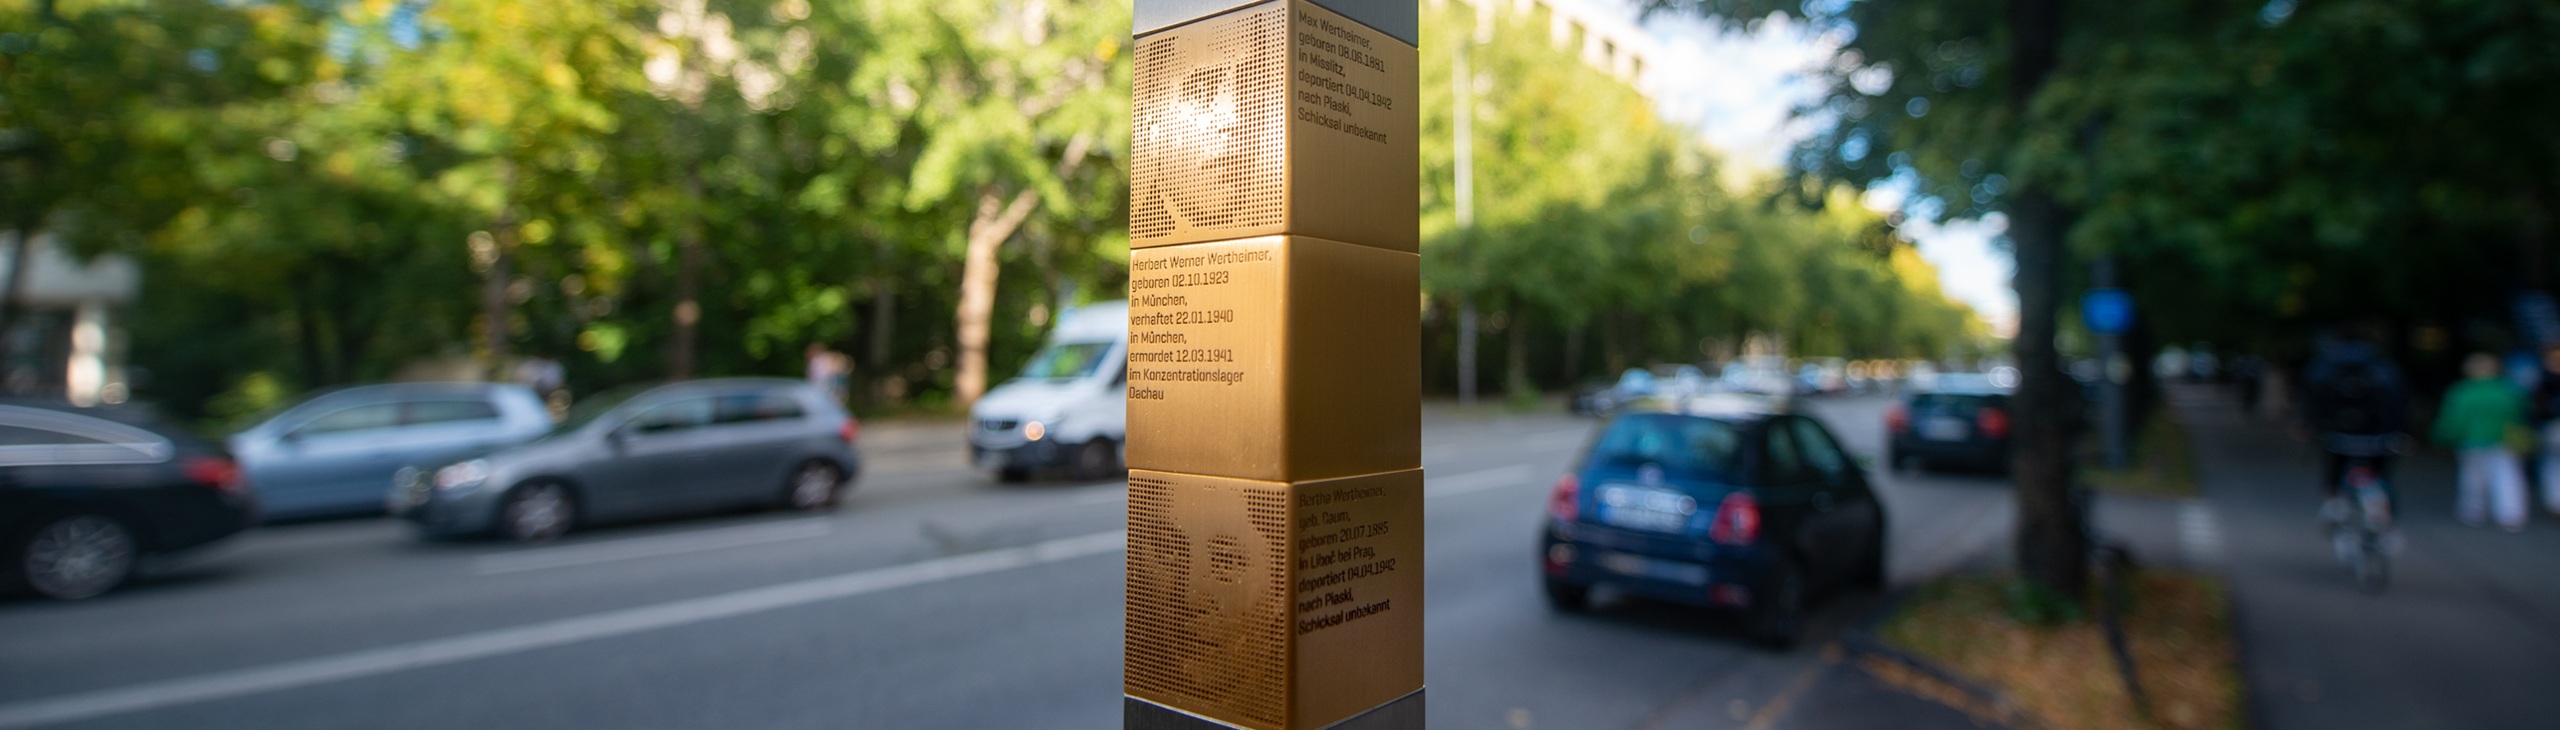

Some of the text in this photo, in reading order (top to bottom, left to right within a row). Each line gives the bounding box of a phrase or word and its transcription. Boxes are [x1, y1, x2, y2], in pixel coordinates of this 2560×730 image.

[1299, 10, 1372, 51] Max Wertheimer,
[1298, 48, 1346, 78] in Misslitz,
[1299, 32, 1385, 73] geboren 08.06.1881
[1298, 69, 1392, 110] deportiert 04.04.1942
[1298, 90, 1352, 117] nach Piaski,
[1298, 107, 1387, 145] Schicksal unbekannt
[1132, 249, 1272, 271] Herbert Werner Wertheimer,
[1131, 271, 1229, 292] geboren 02.10.1923
[1131, 293, 1188, 307] in München,
[1131, 309, 1234, 326] verhaftet 22.01.1940
[1130, 331, 1187, 345] in München,
[1130, 349, 1233, 363] ermordet 12.03.1941
[1129, 368, 1244, 386] im Konzentrationslager
[1129, 386, 1164, 400] Dachau
[1299, 486, 1386, 508] Bertha Wertheimer,
[1299, 514, 1319, 533] geb.
[1299, 532, 1338, 554] geboren
[1299, 557, 1308, 571] in
[1337, 547, 1351, 563] bei
[1353, 546, 1376, 560] Prag,
[1299, 558, 1396, 593] deportiert 04.04.1942
[1299, 587, 1354, 614] nach Piaski,
[1298, 598, 1391, 635] Schicksal unbekannt
